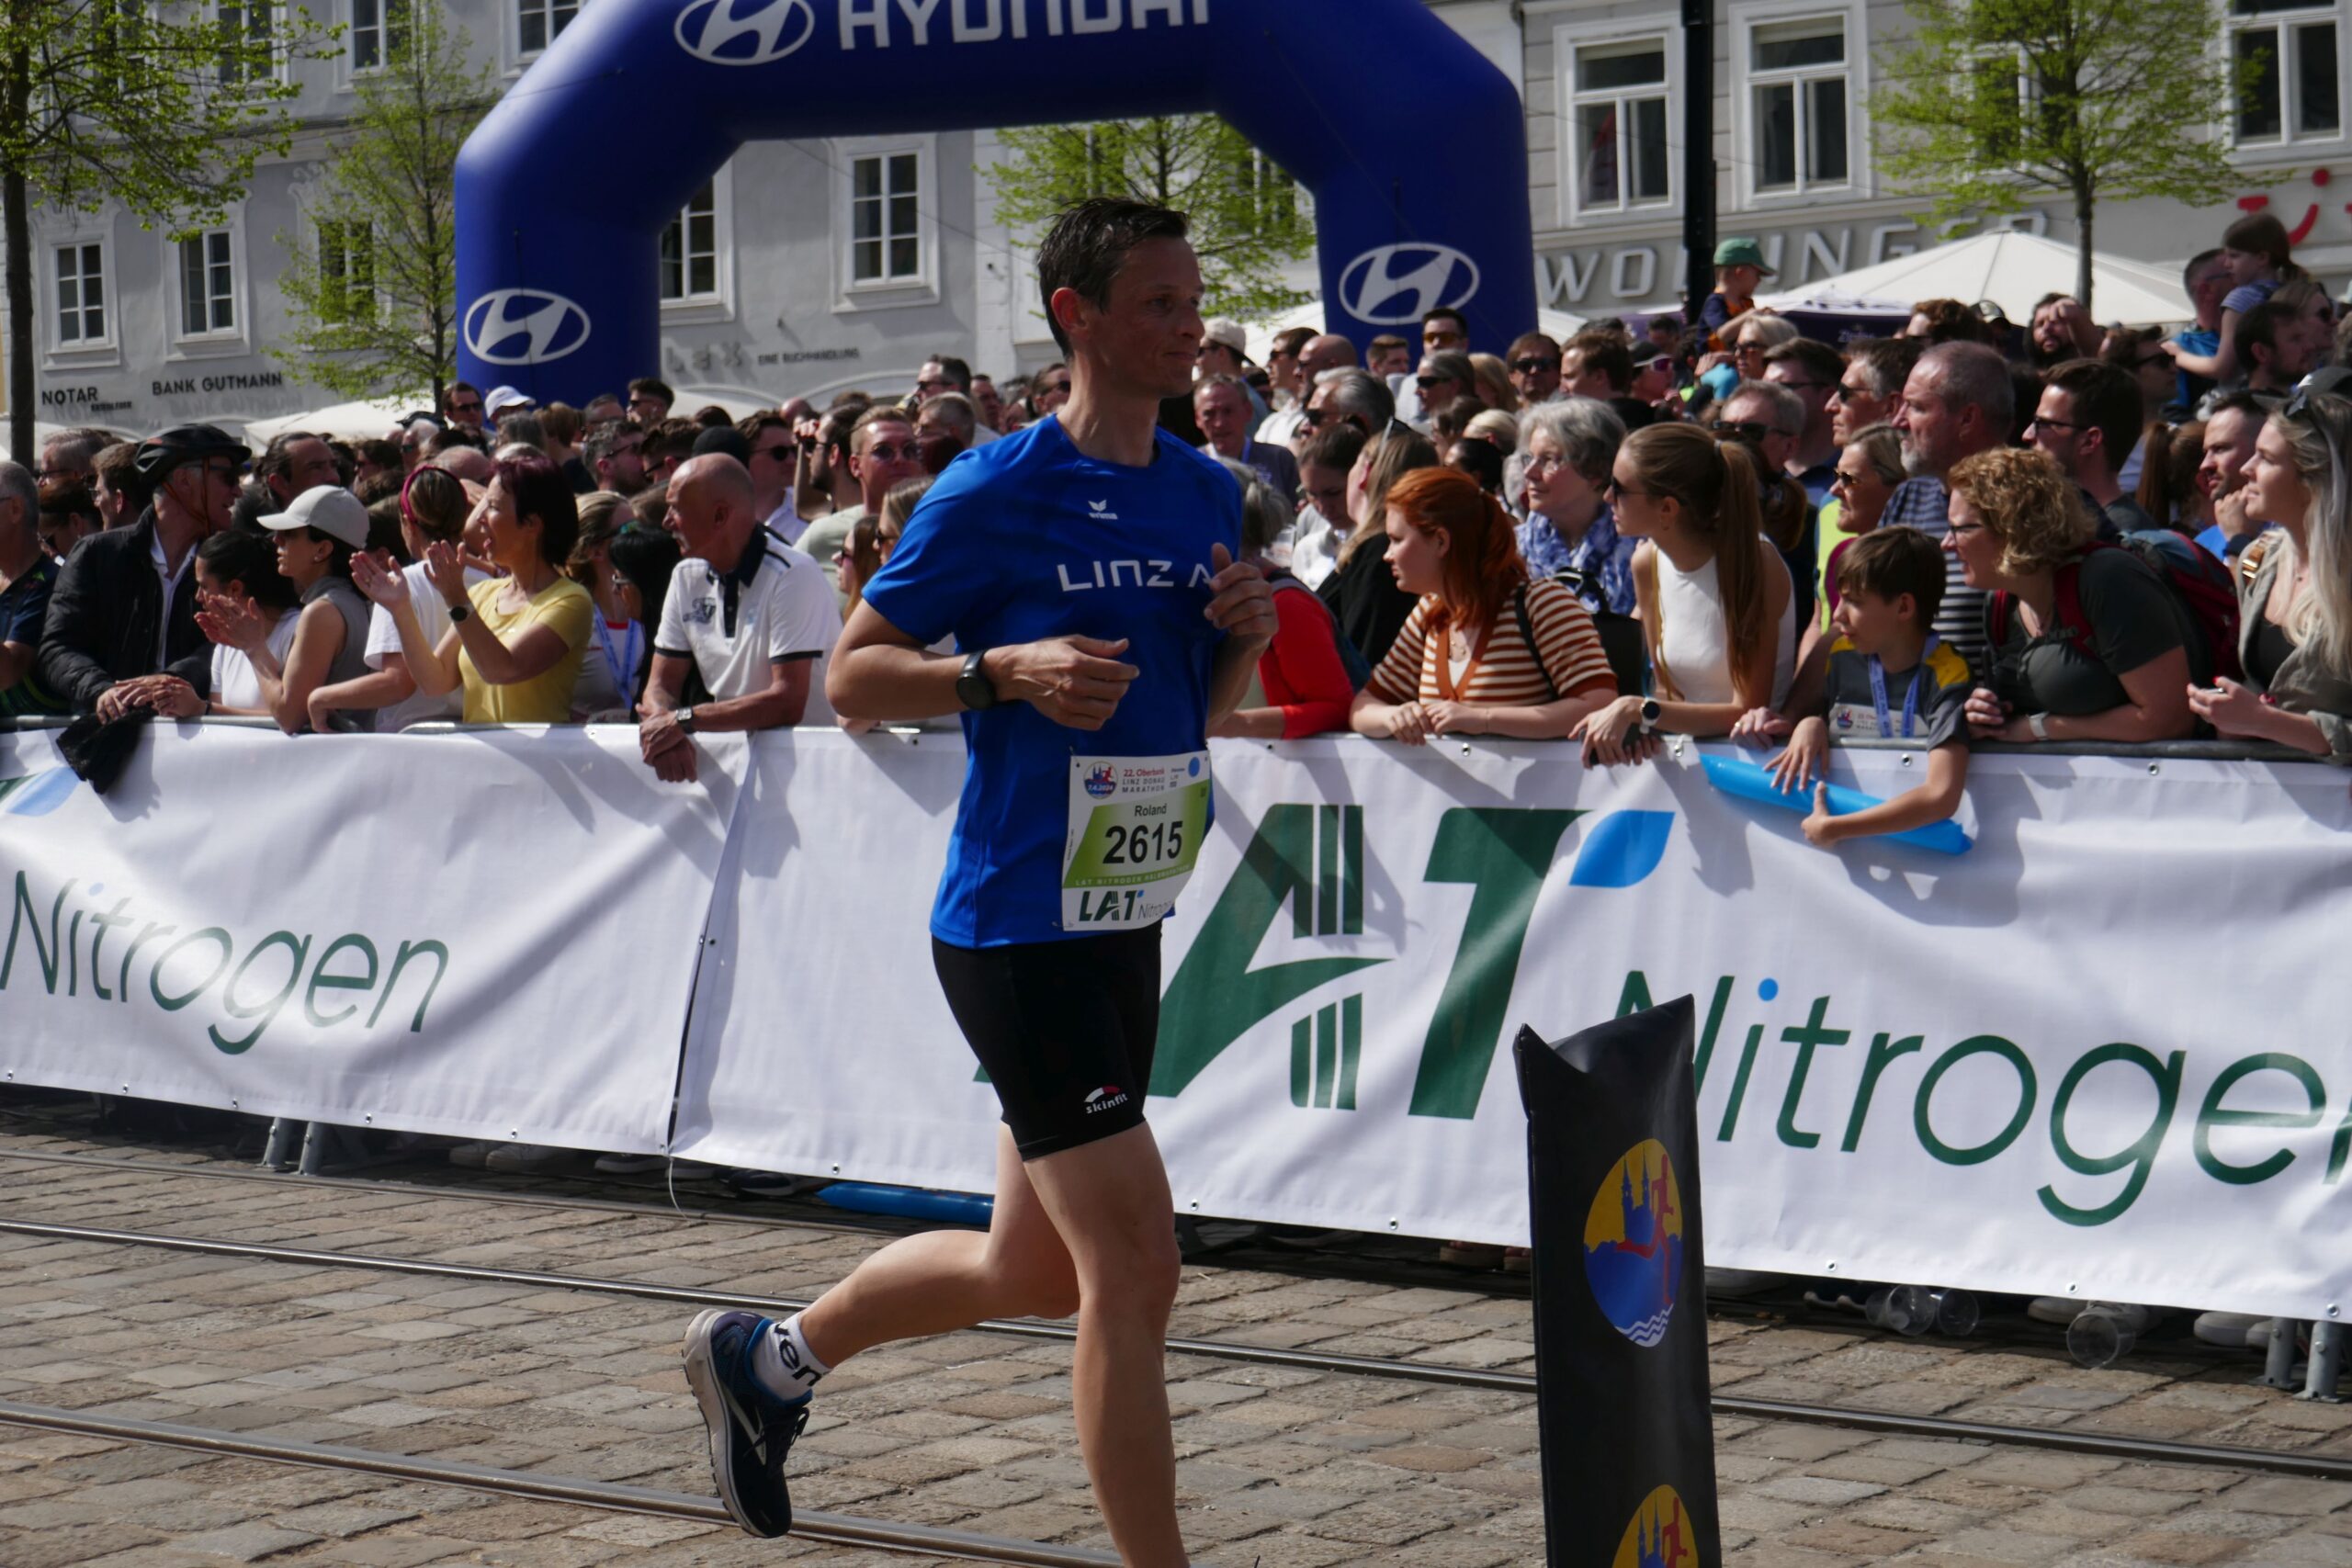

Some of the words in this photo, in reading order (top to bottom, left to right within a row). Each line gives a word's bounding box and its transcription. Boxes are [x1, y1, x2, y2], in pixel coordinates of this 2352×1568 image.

[153, 378, 196, 396] BANK
[202, 372, 283, 392] GUTMANN
[42, 387, 98, 405] NOTAR
[1123, 768, 1136, 778] 22.
[1122, 785, 1165, 794] MARATHON
[1135, 802, 1167, 818] Roland
[1102, 820, 1183, 864] 2615
[1079, 890, 1138, 922] LAT
[0, 871, 449, 1055] Nitrogen
[1086, 1093, 1128, 1114] skinfit
